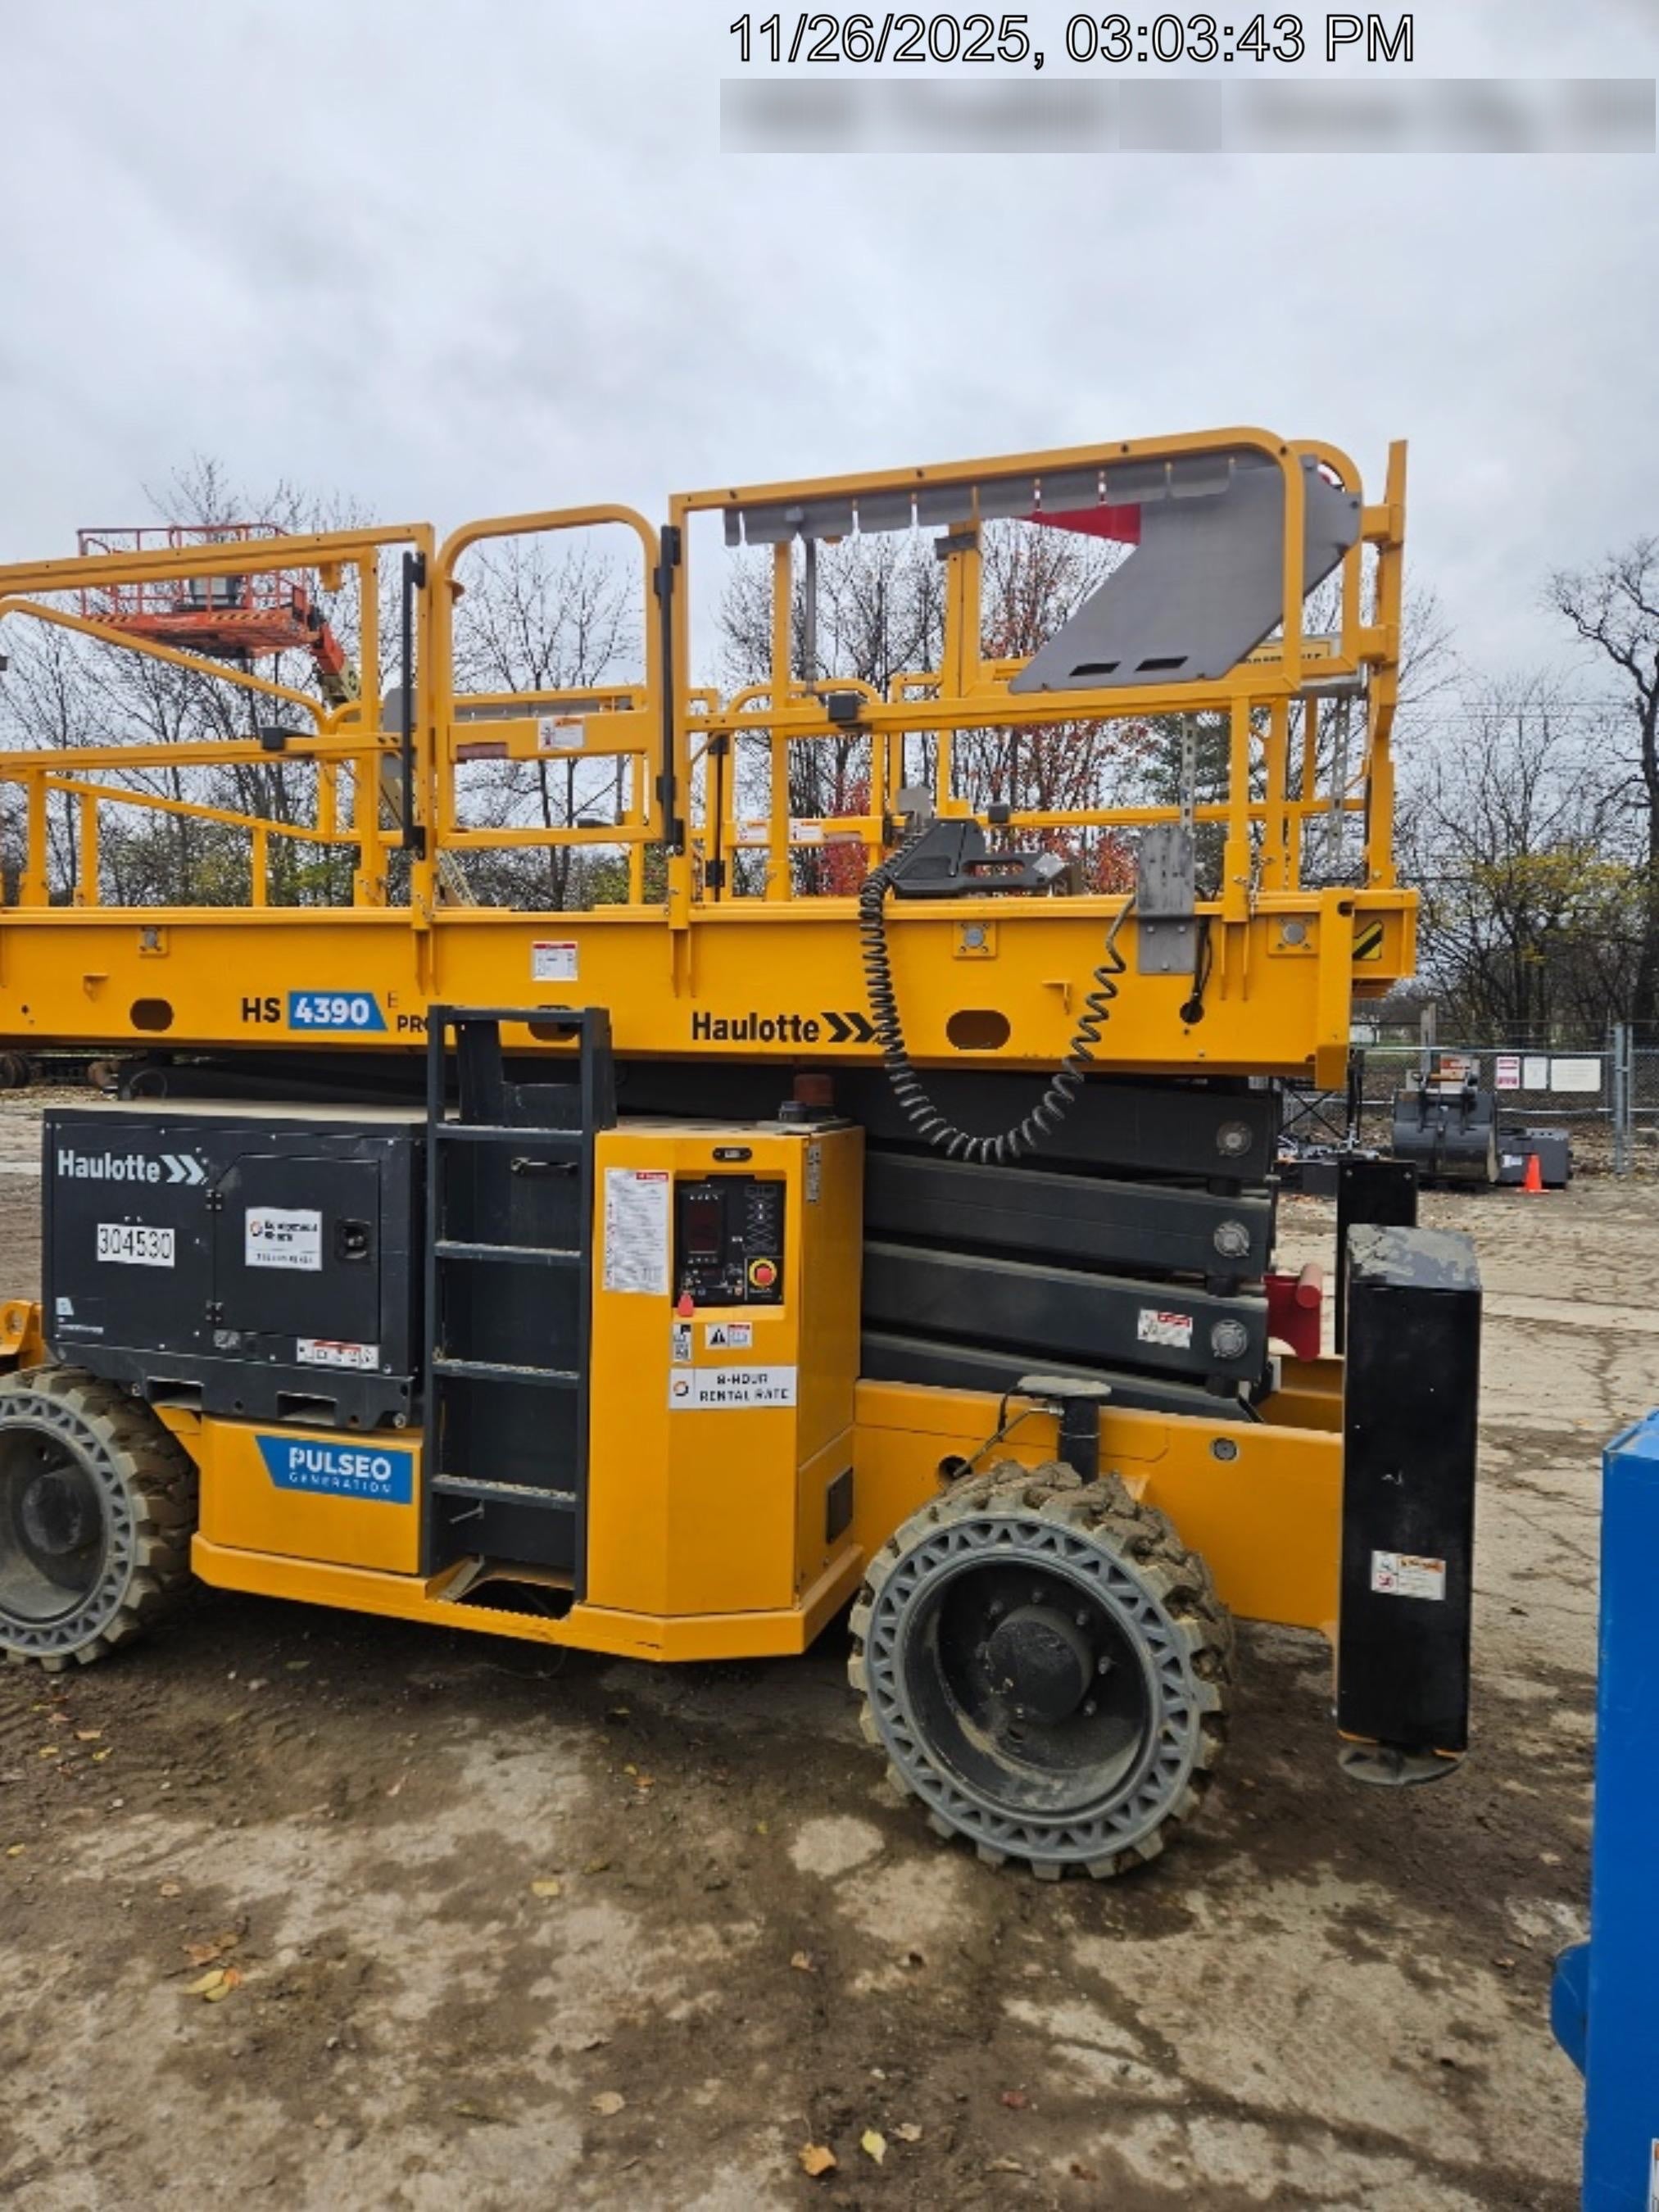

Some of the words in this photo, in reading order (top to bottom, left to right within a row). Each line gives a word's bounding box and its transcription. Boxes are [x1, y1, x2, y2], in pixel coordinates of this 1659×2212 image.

[242, 997, 281, 1023] HS
[294, 996, 369, 1026] 4390
[397, 1014, 428, 1033] PR
[692, 1011, 820, 1043] Haulotte
[57, 1149, 161, 1183] Haulotte
[98, 1227, 173, 1259] 304530
[700, 1389, 750, 1403] RENTAL
[288, 1447, 392, 1481] PULSEO
[288, 1471, 392, 1494] GENERATION
